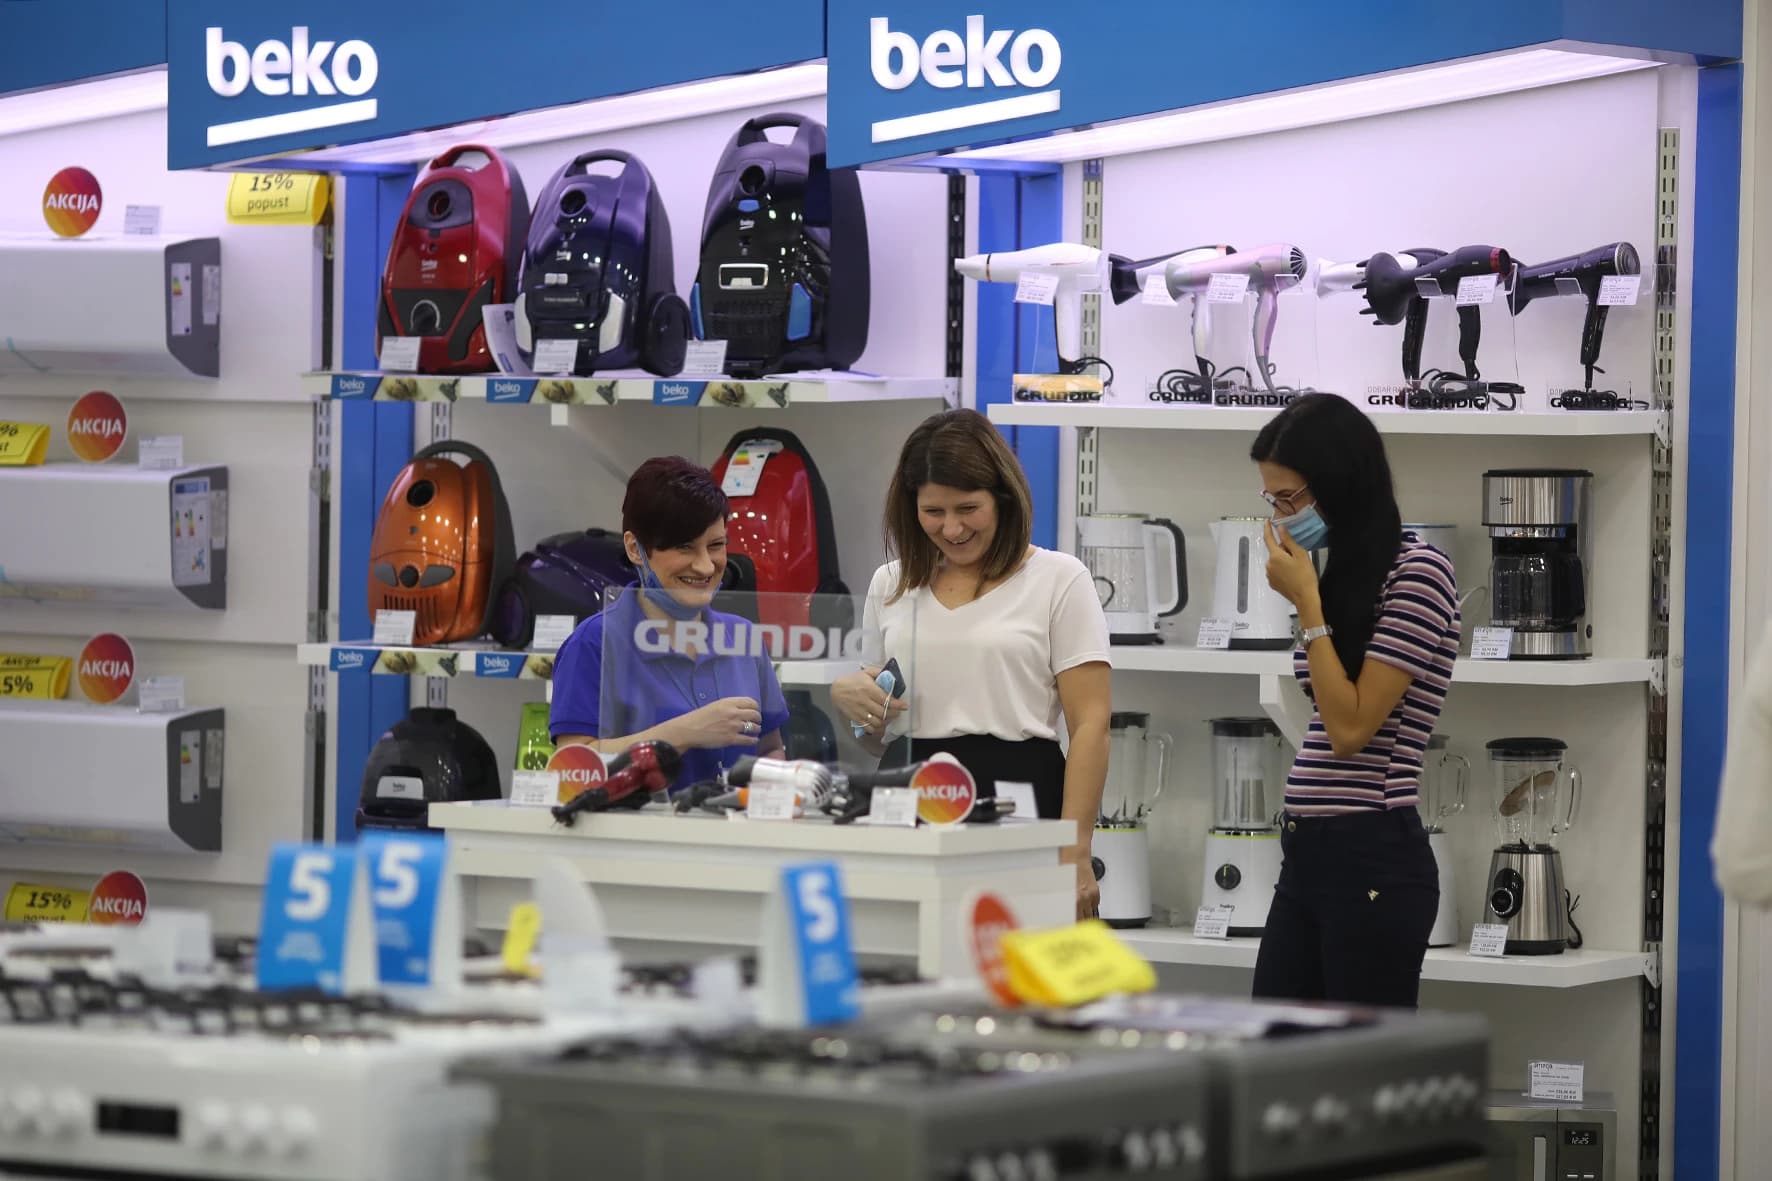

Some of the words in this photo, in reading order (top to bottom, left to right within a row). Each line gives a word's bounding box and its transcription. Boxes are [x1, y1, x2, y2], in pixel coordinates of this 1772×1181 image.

[206, 26, 378, 97] beko
[870, 15, 1061, 90] beko
[249, 173, 294, 192] 15%
[46, 193, 99, 214] AKCIJA
[247, 197, 289, 212] popust
[339, 377, 365, 390] beko
[494, 381, 521, 393] beko
[662, 383, 689, 396] beko
[1016, 388, 1101, 402] GRUNDIG
[71, 418, 122, 438] AKCIJA
[338, 650, 364, 663] beko
[483, 655, 510, 668] beko
[80, 659, 130, 680] AKCIJA
[0, 675, 34, 695] 5%
[554, 768, 602, 785] KCIJA
[376, 841, 424, 909] 5
[284, 851, 335, 922] 5
[25, 891, 72, 910] 15%
[92, 896, 142, 918] AKCIJA
[799, 869, 839, 943] 5
